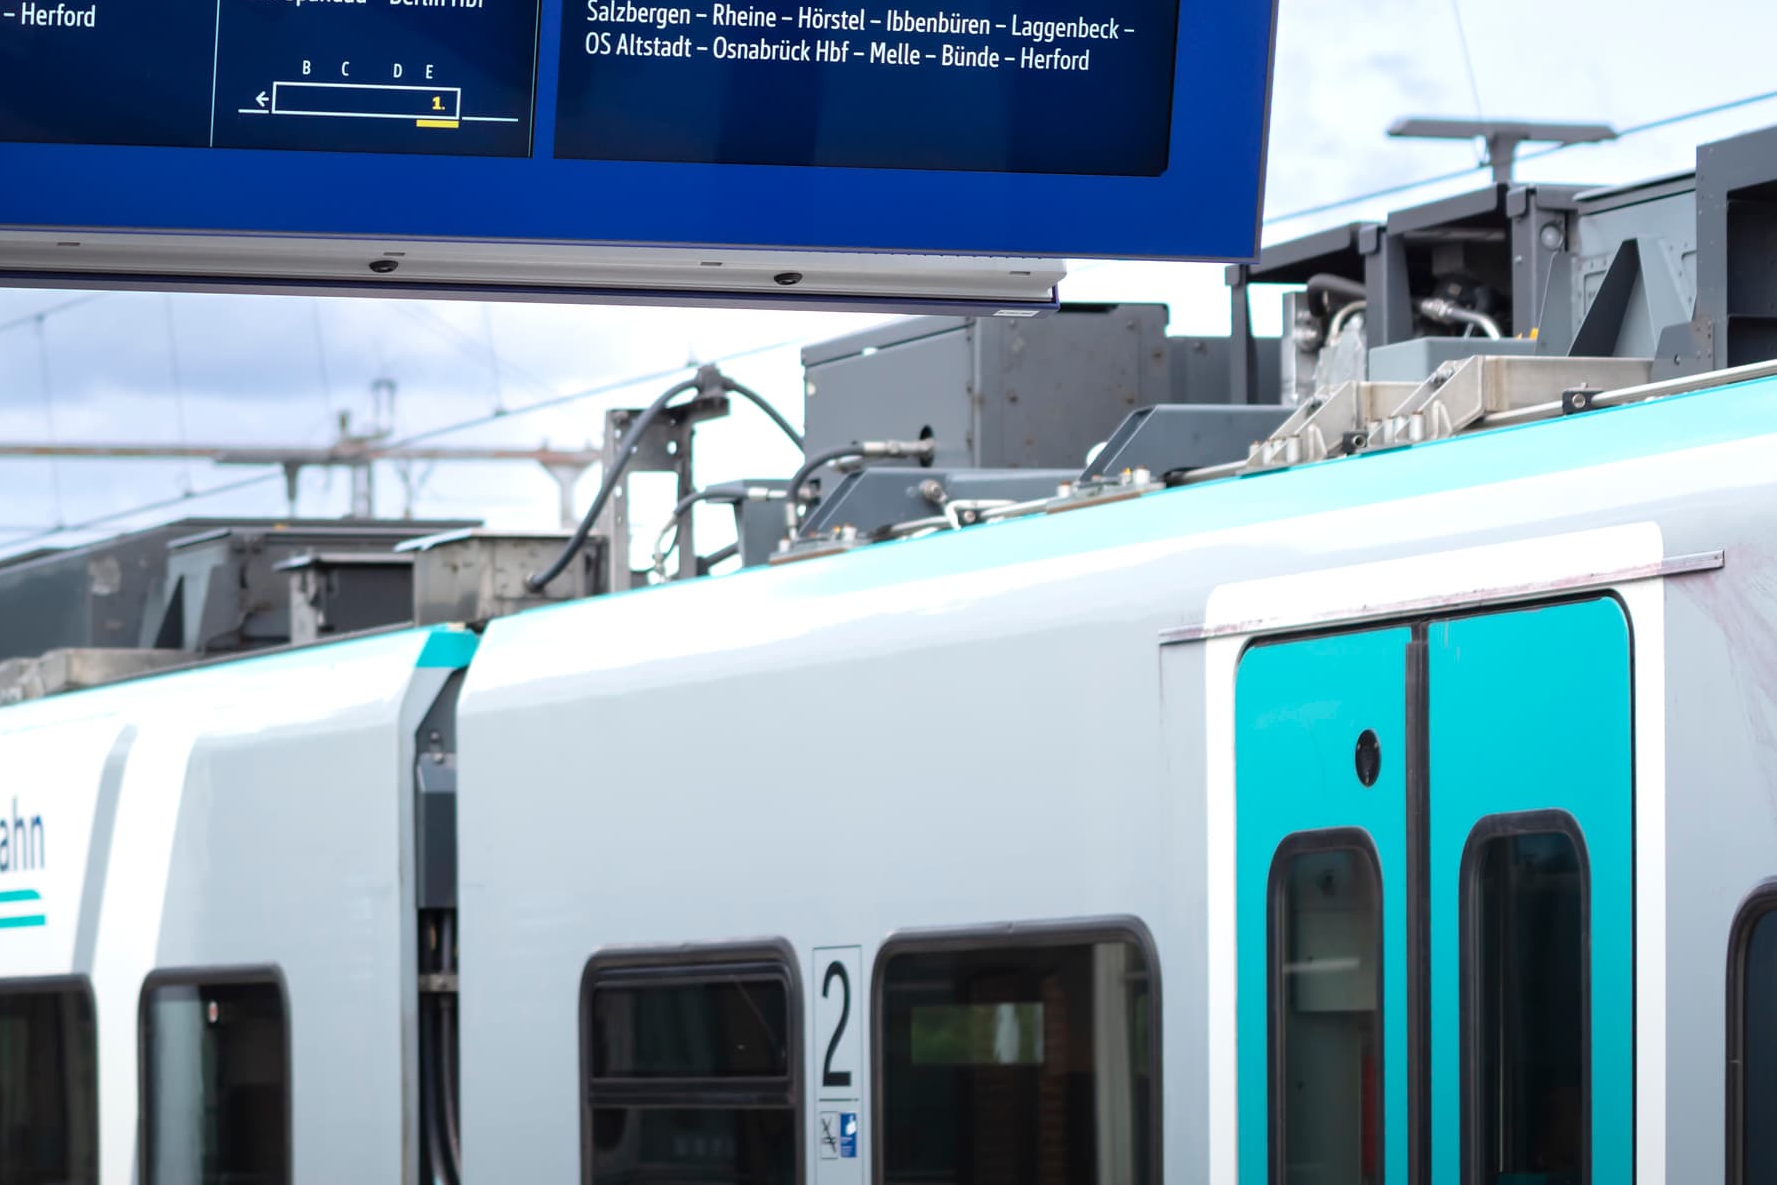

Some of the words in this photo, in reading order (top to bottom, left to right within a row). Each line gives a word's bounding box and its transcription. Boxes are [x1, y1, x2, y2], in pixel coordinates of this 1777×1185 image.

[21, 1, 96, 28] Herford
[712, 3, 777, 28] Rheine
[798, 6, 865, 31] Hörstel
[886, 9, 990, 36] Ibbenbüren
[1011, 13, 1119, 43] Laggenbeck
[585, 31, 611, 56] OS
[615, 33, 692, 58] Altstadt
[713, 36, 811, 62] Osnabrück
[815, 39, 850, 63] Hbf
[869, 41, 921, 65] Melle
[941, 44, 1000, 68] Bünde
[1020, 46, 1090, 71] Herford
[302, 59, 311, 76] B
[341, 61, 350, 77] C
[393, 63, 403, 78] D
[425, 64, 434, 80] E
[431, 96, 446, 110] 1.
[821, 959, 851, 1087] 2
